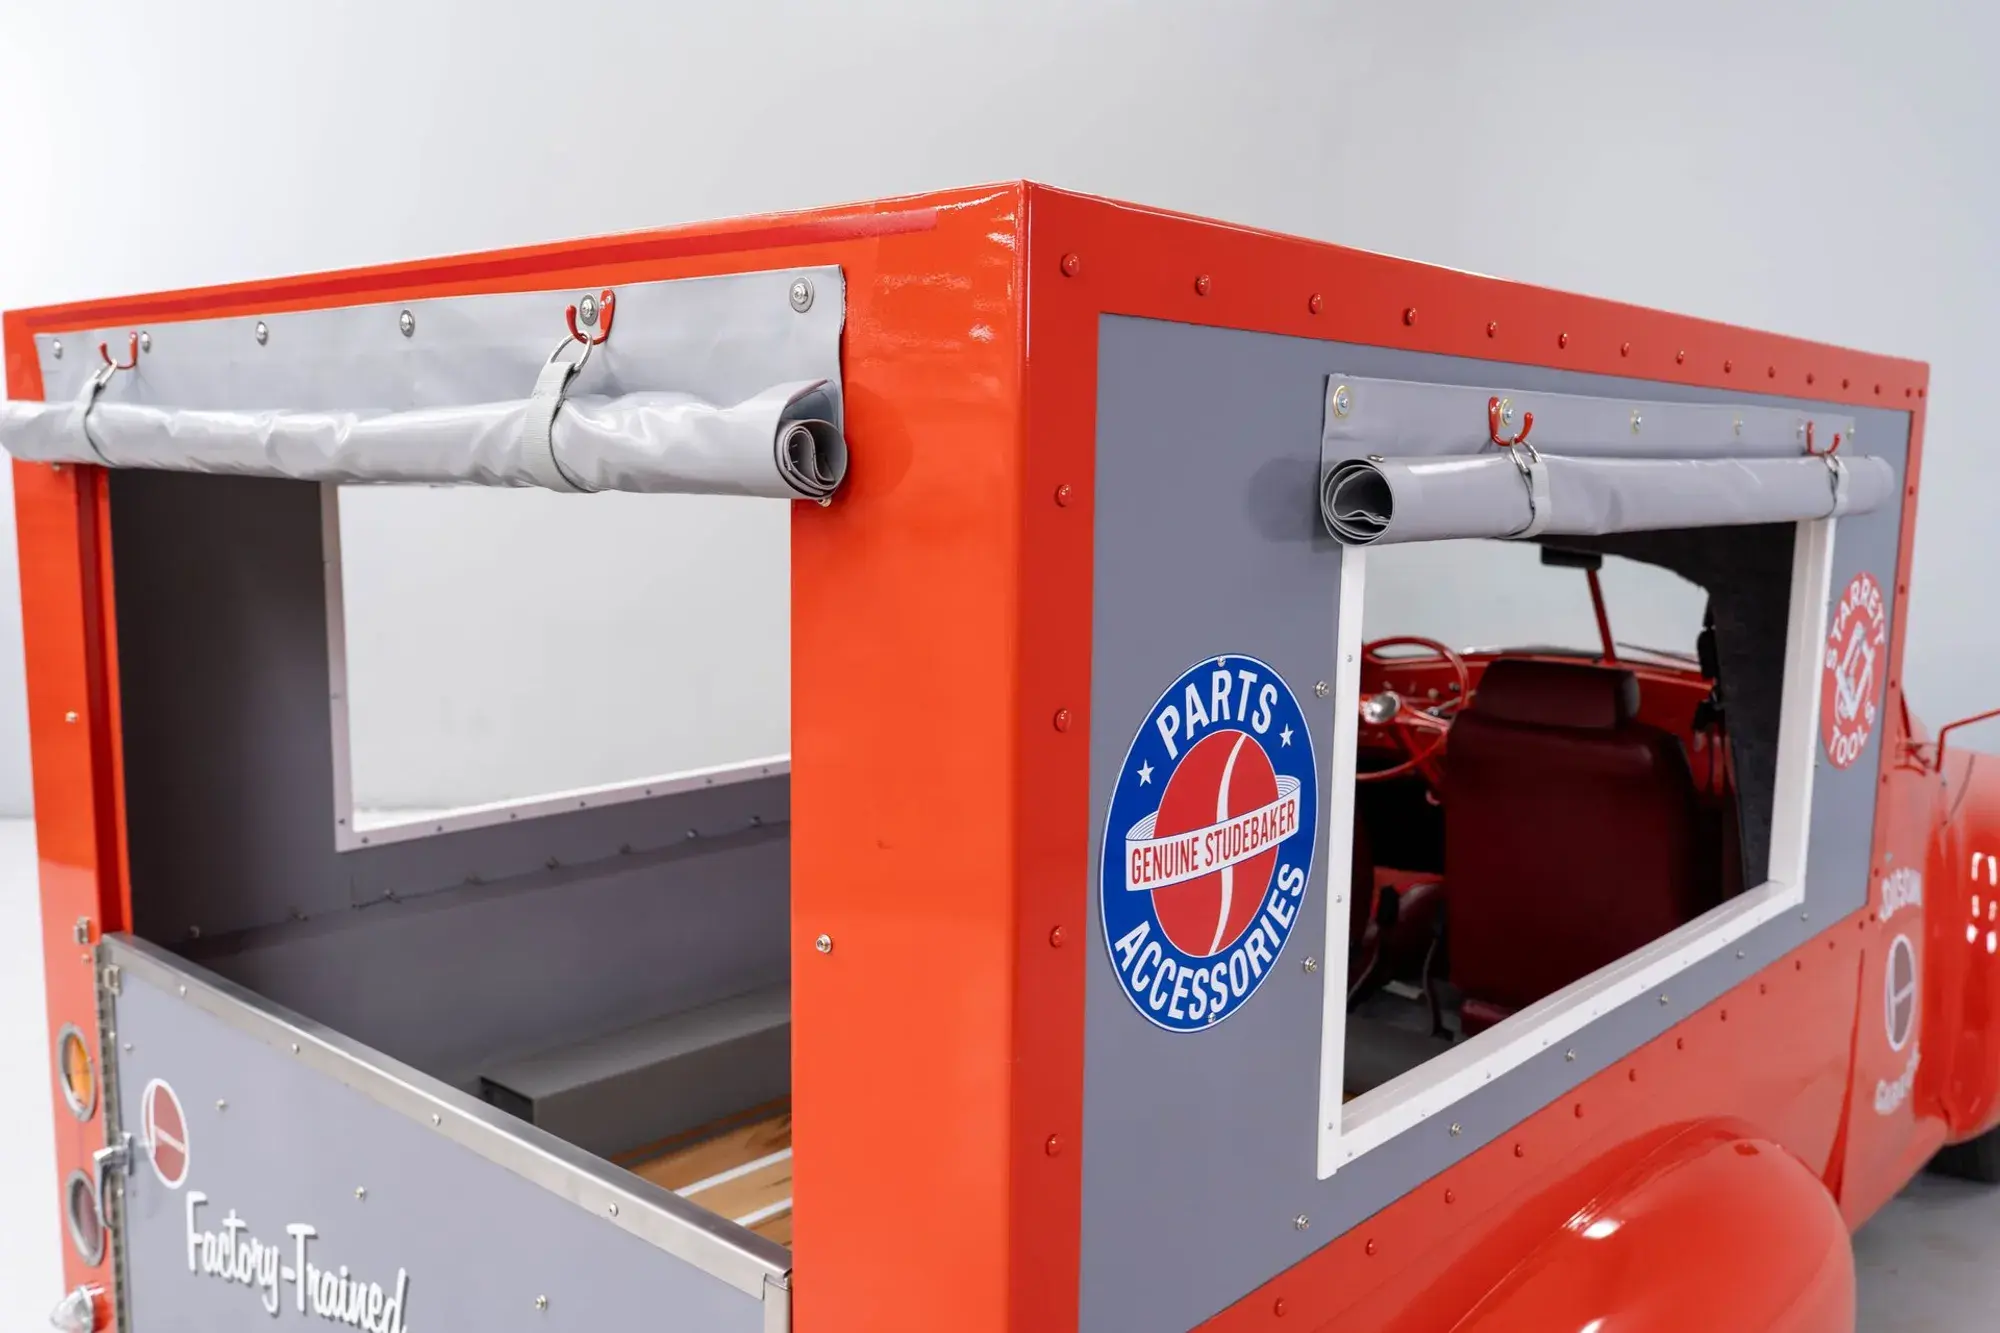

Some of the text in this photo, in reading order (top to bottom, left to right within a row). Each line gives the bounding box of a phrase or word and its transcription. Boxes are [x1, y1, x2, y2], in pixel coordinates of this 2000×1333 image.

[1825, 577, 1885, 671] STARRETT
[1156, 669, 1279, 761] PARTS
[1829, 701, 1876, 765] TOOLS
[1131, 798, 1296, 885] GENUINE STUDEBAKER
[1114, 862, 1305, 1021] ACCESSORIES
[185, 1190, 409, 1333] Factory-Trained
